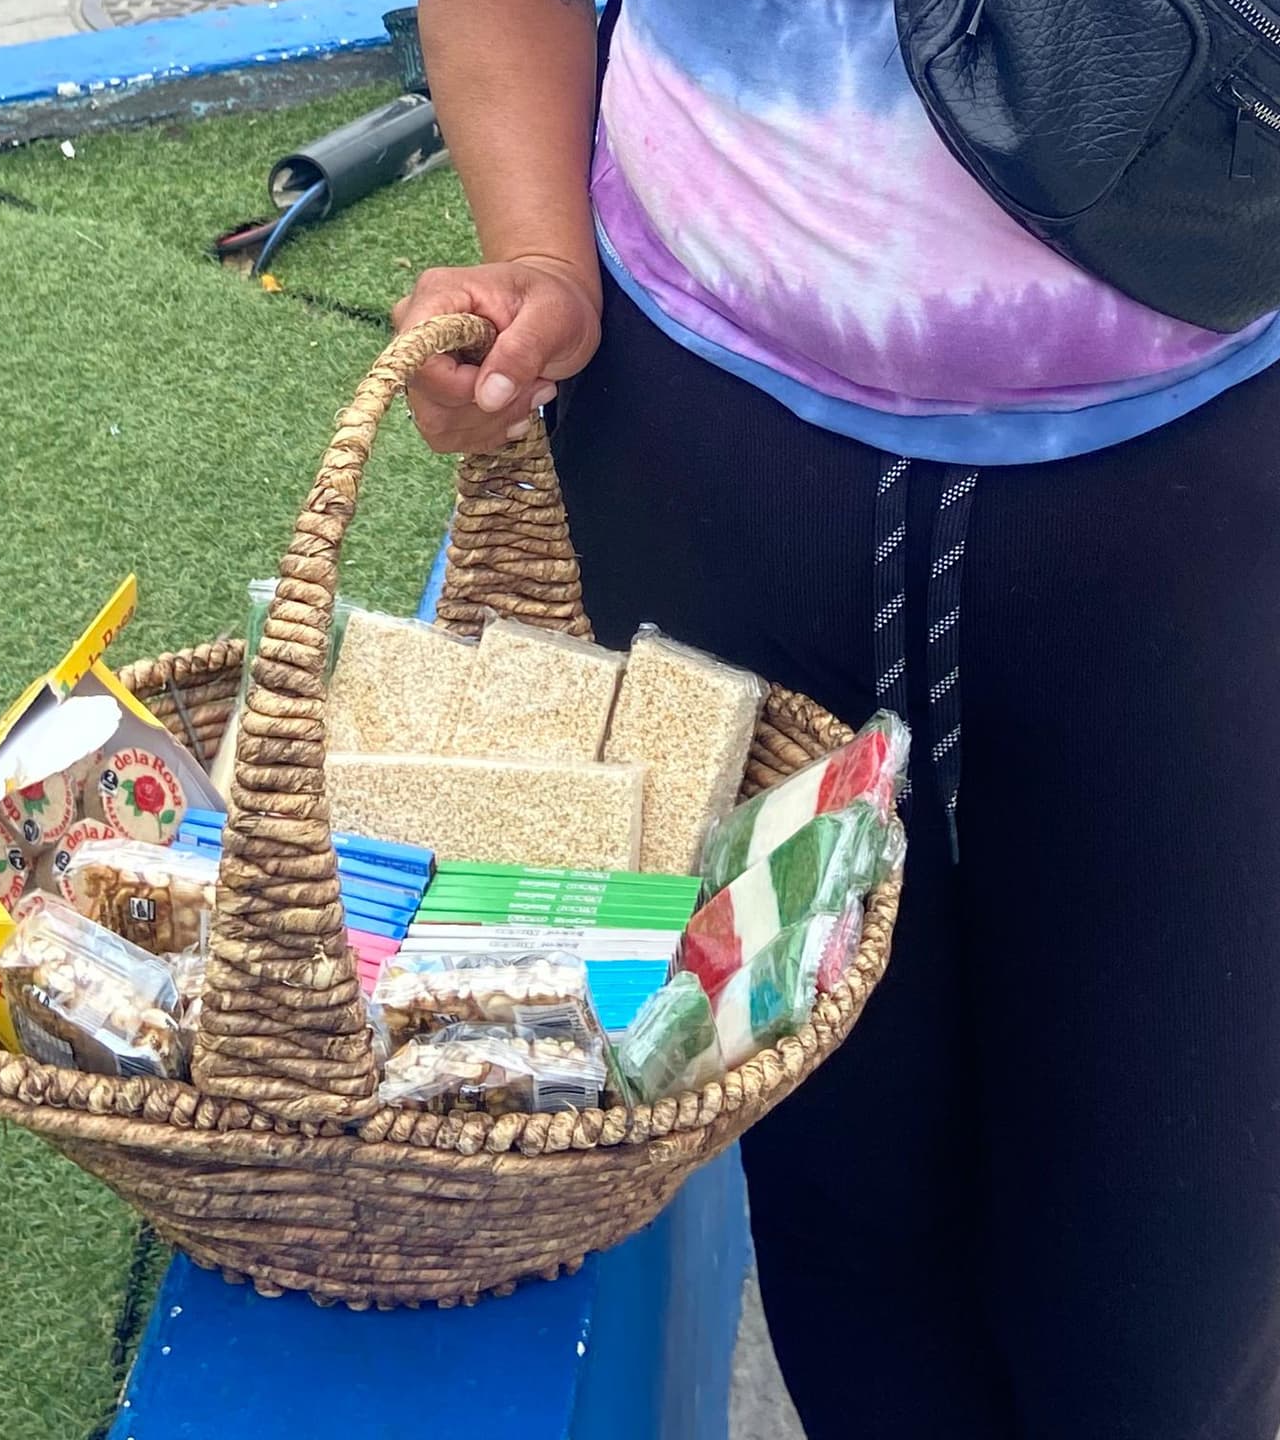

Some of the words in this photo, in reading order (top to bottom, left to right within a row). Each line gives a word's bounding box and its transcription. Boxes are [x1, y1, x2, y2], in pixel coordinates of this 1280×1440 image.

[106, 770, 115, 783] 2
[114, 754, 133, 771] de
[132, 748, 149, 766] la
[152, 756, 183, 809] Rosa
[66, 829, 84, 850] de
[82, 822, 99, 840] la
